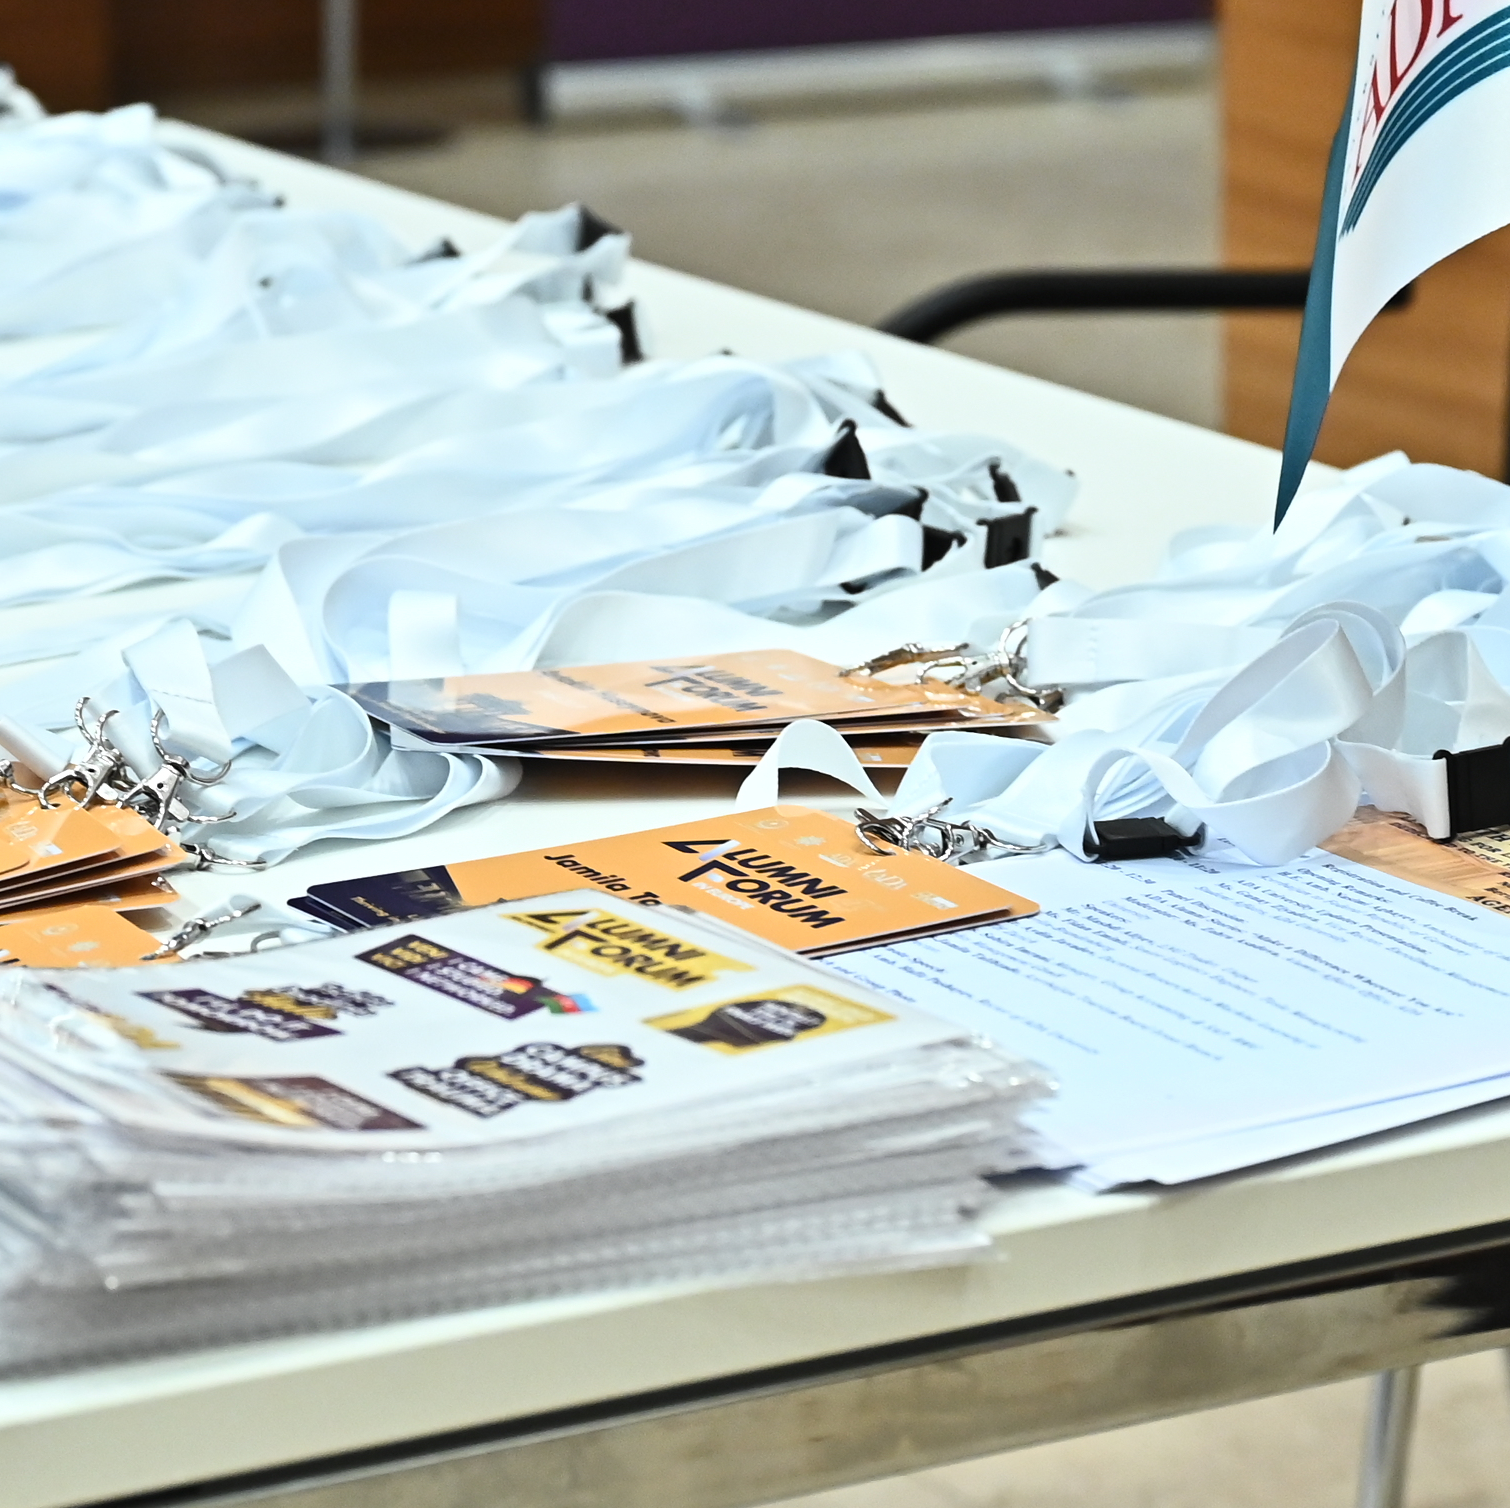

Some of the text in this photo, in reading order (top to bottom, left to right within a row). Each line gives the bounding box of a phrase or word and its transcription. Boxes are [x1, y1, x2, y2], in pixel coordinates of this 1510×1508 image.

[544, 853, 631, 895] Jamila
[662, 838, 848, 900] ALUMNI
[677, 862, 847, 930] FORUM
[525, 909, 708, 962] ALUMNI
[542, 930, 707, 987] FORUM
